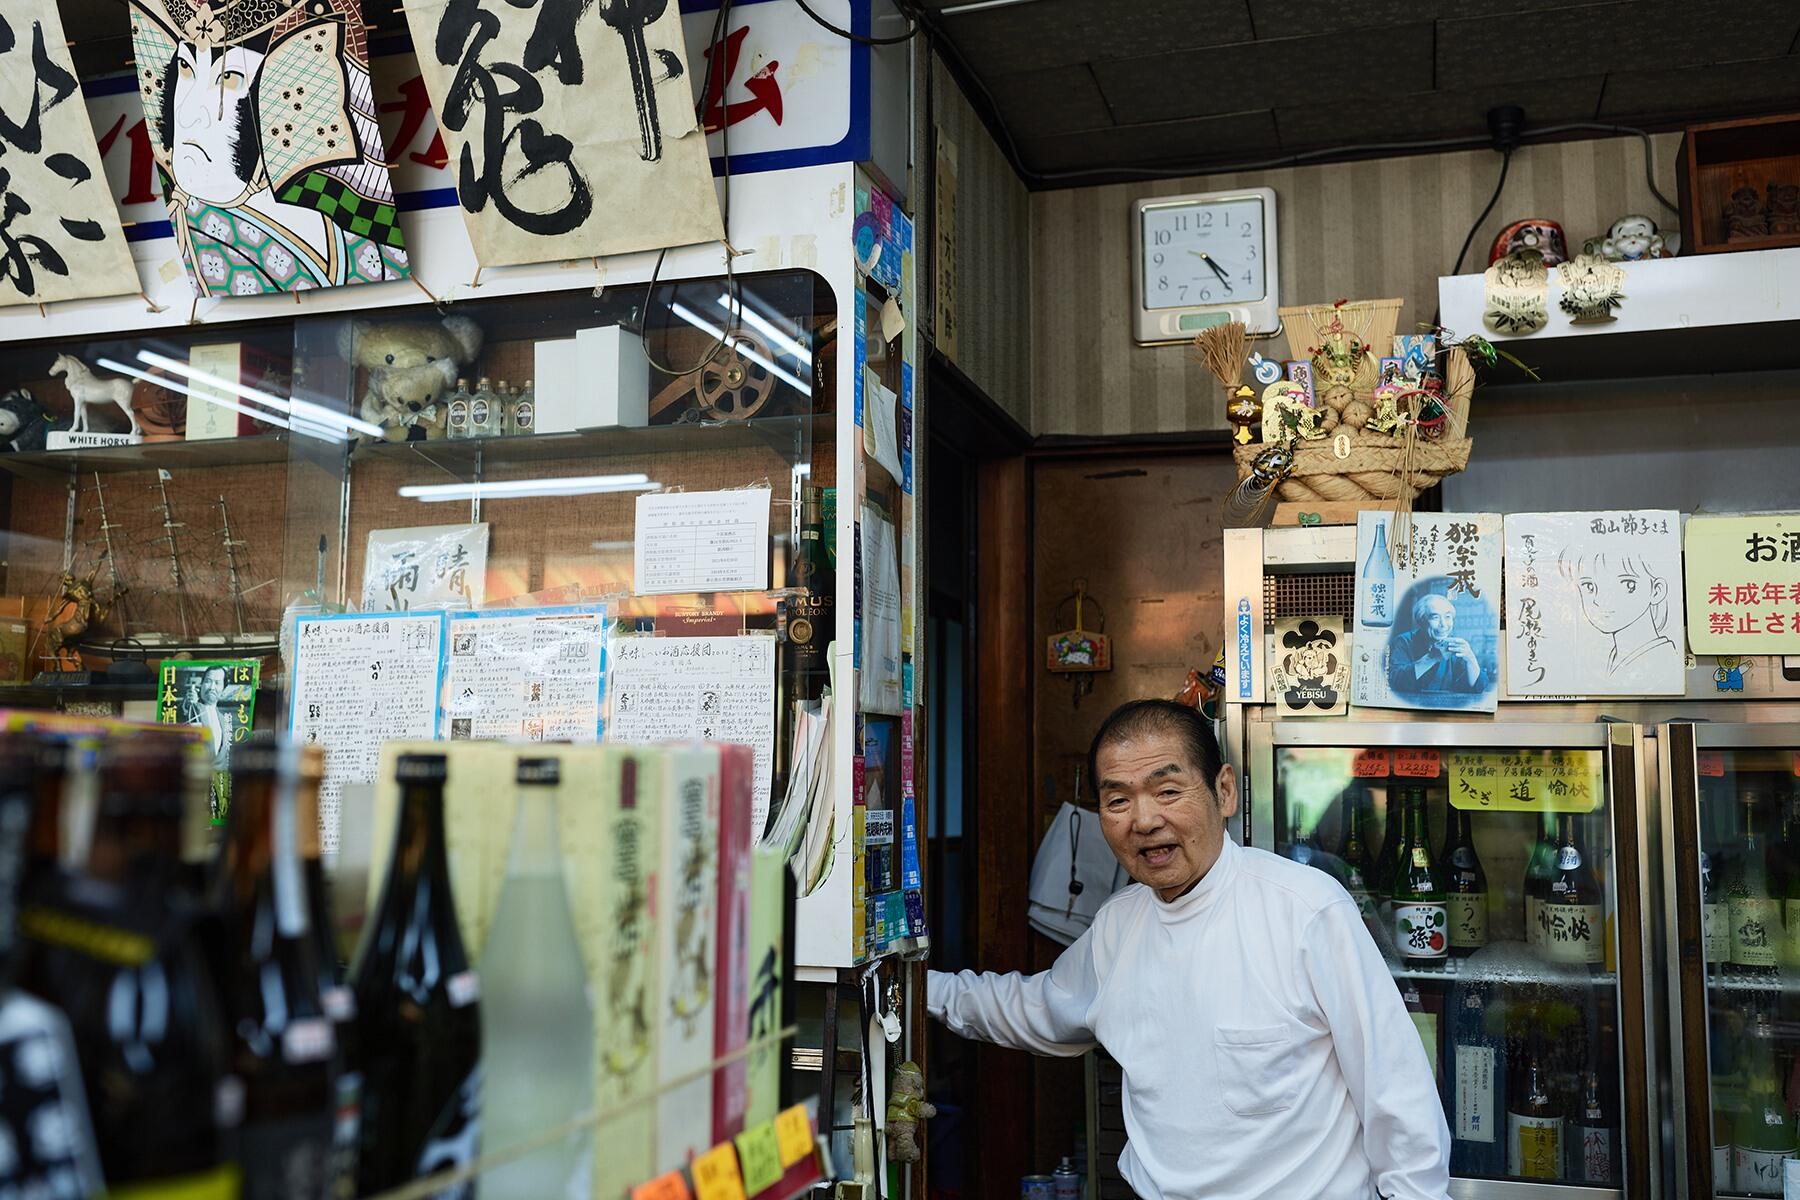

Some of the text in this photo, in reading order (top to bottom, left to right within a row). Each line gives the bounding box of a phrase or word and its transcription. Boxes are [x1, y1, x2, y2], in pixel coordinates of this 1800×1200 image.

[1175, 215, 1188, 231] 11
[1195, 212, 1213, 228] 12
[1224, 212, 1230, 227] 1
[1154, 230, 1171, 246] 10
[1241, 222, 1252, 238] 2
[1153, 252, 1165, 268] 9
[1246, 245, 1256, 261] 3
[1158, 275, 1169, 291] 8
[1241, 269, 1252, 285] 4
[1177, 285, 1189, 301] 7
[1199, 286, 1211, 301] 6
[1223, 281, 1234, 297] 5
[69, 436, 130, 448] WHITE HORSE
[1590, 513, 1670, 535] 西山節子さま
[162, 666, 177, 724] 日本酒
[1296, 691, 1326, 699] YEBISU
[1459, 778, 1492, 806] うさぎ
[1510, 778, 1536, 801] 道
[1548, 780, 1590, 799] 愉快
[1538, 910, 1591, 941] 愉快
